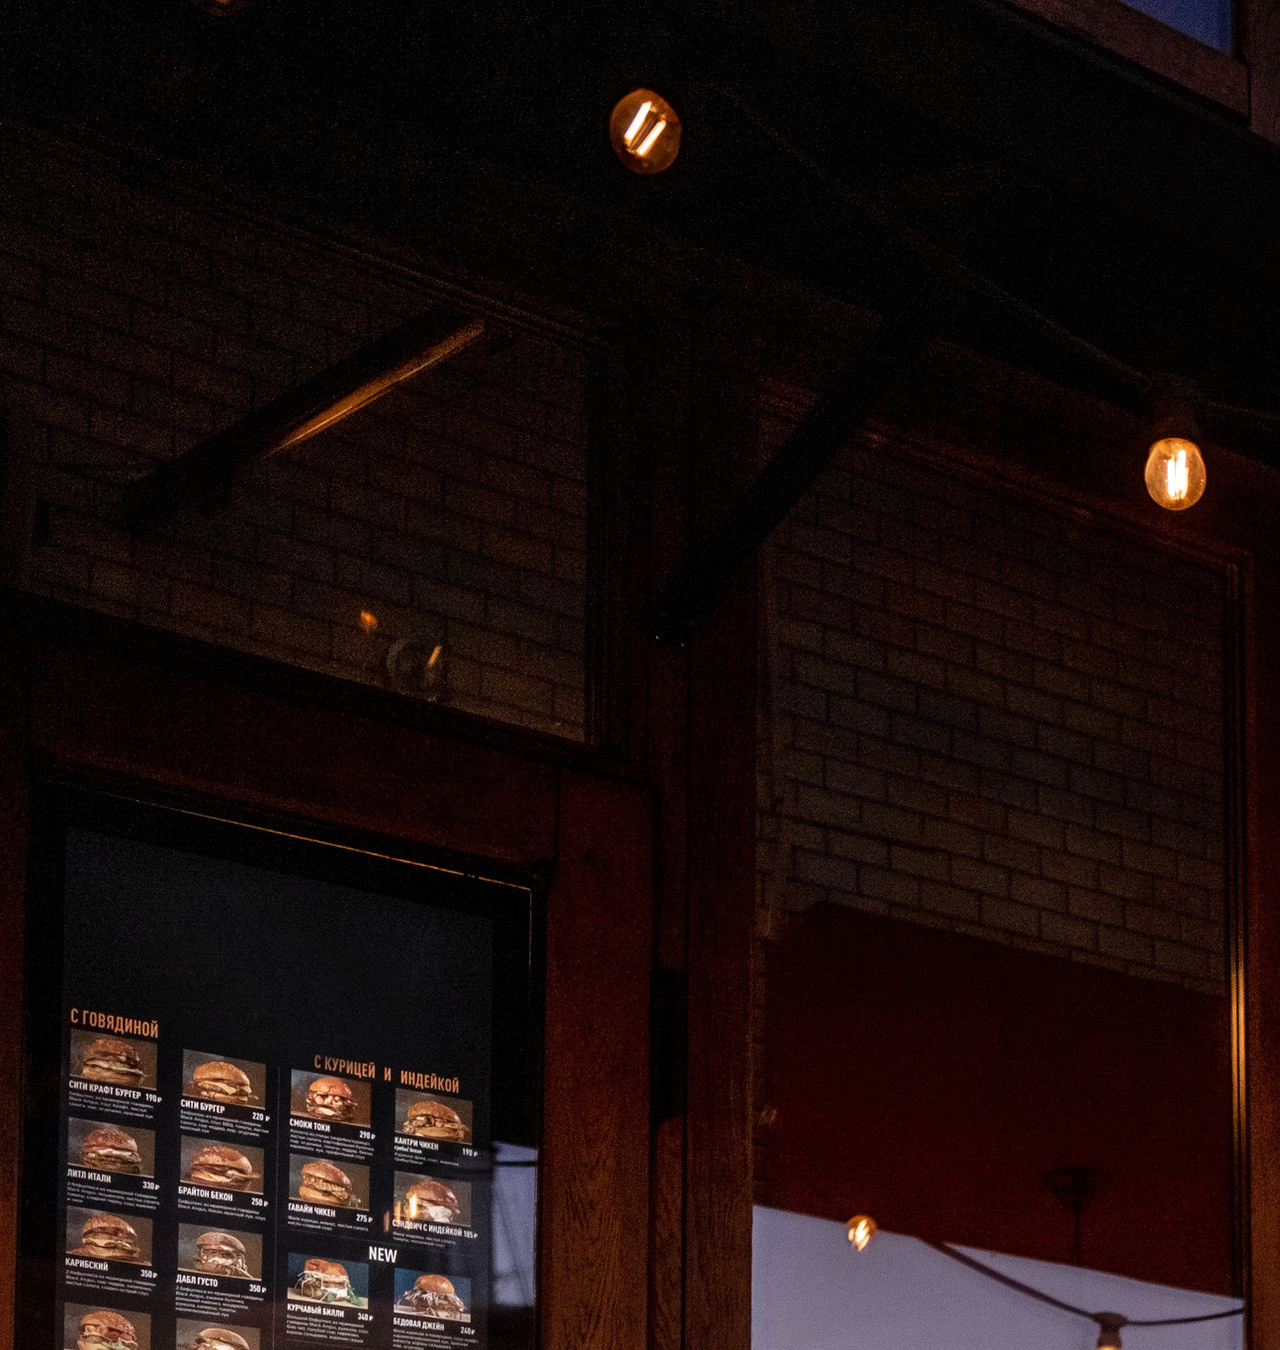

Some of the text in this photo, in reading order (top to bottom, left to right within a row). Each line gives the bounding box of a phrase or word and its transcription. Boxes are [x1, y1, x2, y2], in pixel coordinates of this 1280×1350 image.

[70, 1007, 160, 1038] С ГОВЯДИНОЙ
[314, 1054, 460, 1094] С КУРИЦЕЙ И ИНДЕЙКОЙ
[69, 1080, 88, 1091] СИТИ
[89, 1083, 114, 1096] КРАФТ
[115, 1088, 142, 1100] БУРГЕР
[180, 1099, 199, 1110] СИТИ
[200, 1102, 225, 1114] БУРГЕР
[252, 1112, 264, 1121] 220
[289, 1118, 312, 1129] СМОКИ
[313, 1122, 331, 1132] ТОКИ
[359, 1130, 370, 1139] 290
[394, 1136, 418, 1148] КАНТРИ
[418, 1140, 439, 1151] ЧИКЕН
[462, 1147, 473, 1156] 190
[67, 1168, 87, 1180] ЛИТЛ
[88, 1173, 112, 1183] ИТАЛИ
[142, 1180, 154, 1190] 330
[178, 1186, 210, 1199] БРАЙТОН
[210, 1191, 233, 1202] БЕКОН
[251, 1198, 263, 1206] 250
[288, 1202, 313, 1215] ГАВАЙИ
[314, 1207, 336, 1218] ЧИКЕН
[356, 1213, 368, 1222] 275
[423, 1224, 428, 1232] С
[428, 1225, 463, 1238] ИНДЕЙКОЙ
[368, 1246, 398, 1263] NEW
[65, 1257, 109, 1271] КАРИБСКИЙ
[140, 1269, 152, 1278] 350
[176, 1274, 196, 1285] ДАБЛ
[197, 1277, 218, 1287] ГУСТО
[249, 1284, 261, 1293] 350
[287, 1303, 322, 1316] КУРЧАВЫЙ
[322, 1308, 345, 1318] БИЛЛИ
[357, 1312, 369, 1322] 340
